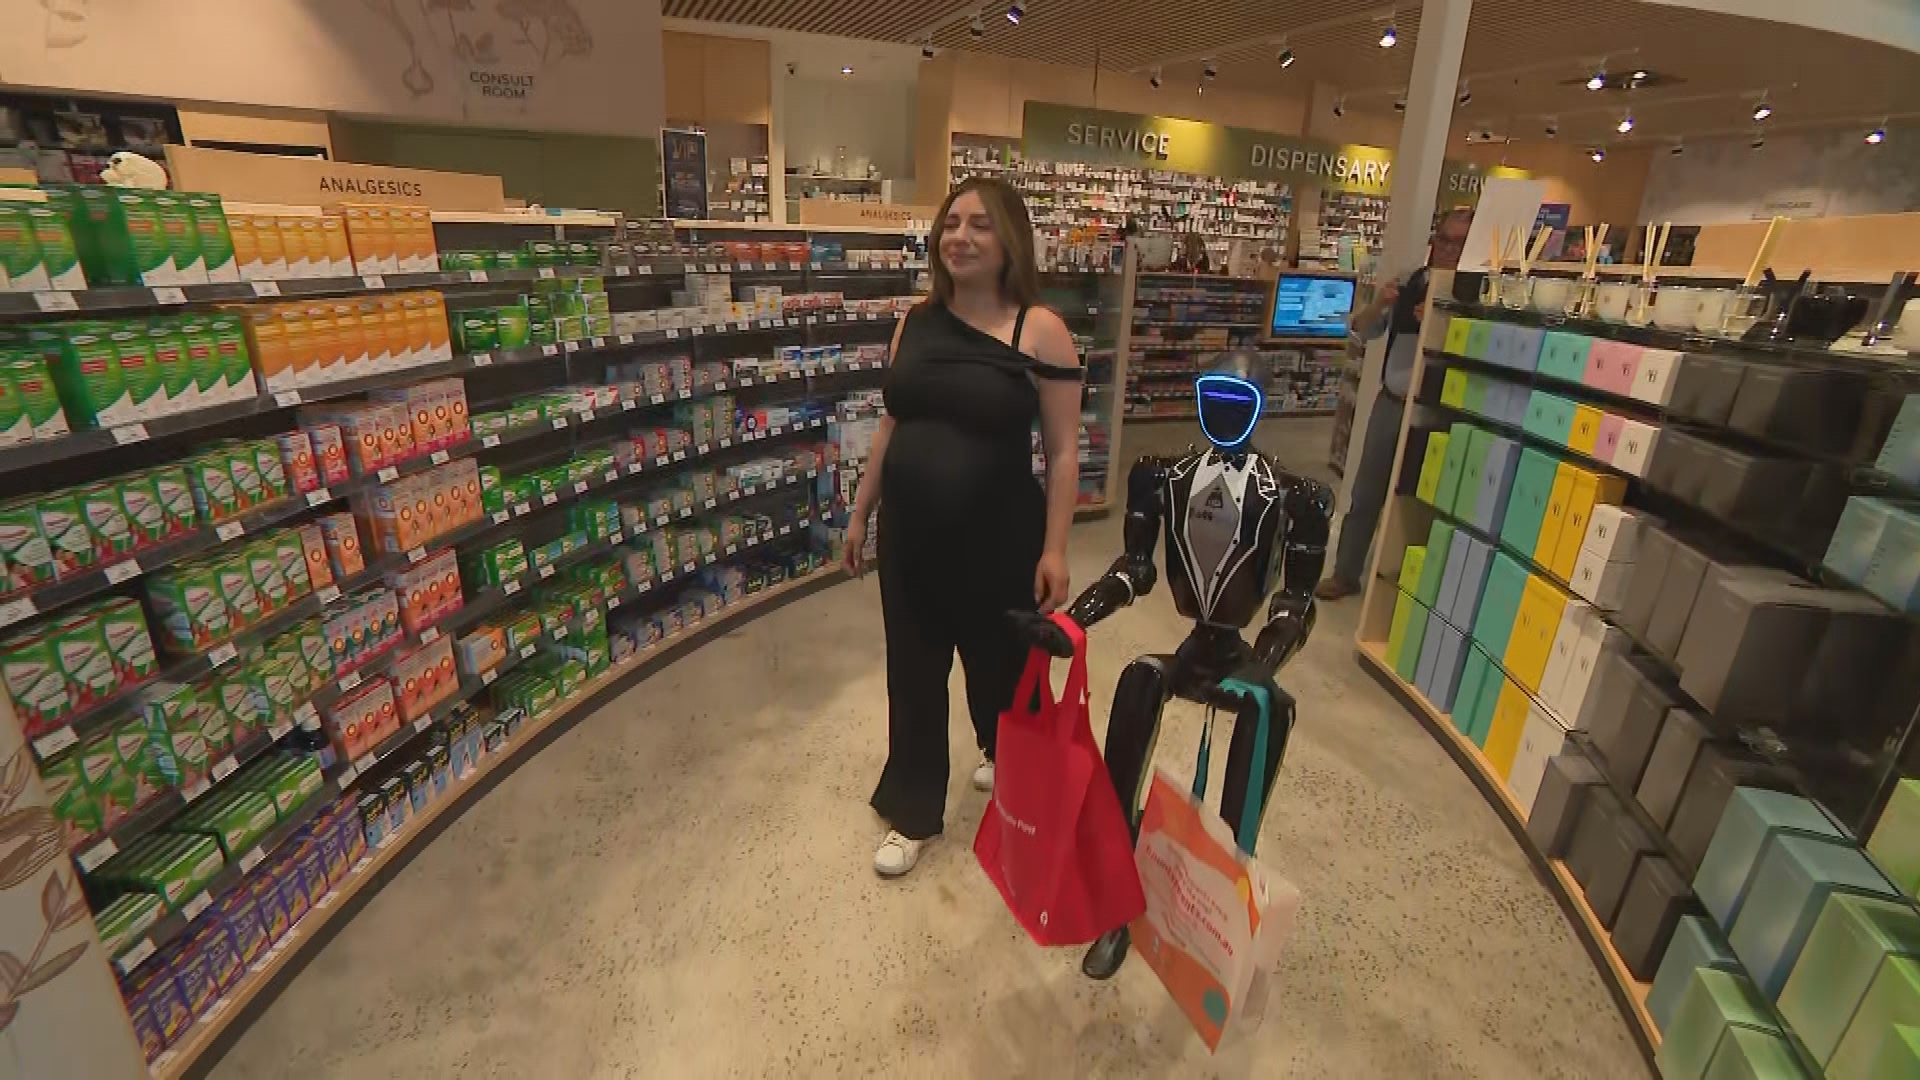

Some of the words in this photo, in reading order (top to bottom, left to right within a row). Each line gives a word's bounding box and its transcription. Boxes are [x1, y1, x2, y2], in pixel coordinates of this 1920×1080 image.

[470, 71, 534, 87] CONSULT
[482, 86, 526, 98] ROOM
[1067, 123, 1171, 157] SERVICE
[1251, 144, 1391, 184] DISPENSARY
[319, 176, 422, 197] ANALGESICS
[1449, 173, 1487, 193] SERV
[860, 209, 912, 221] ANALGESICS
